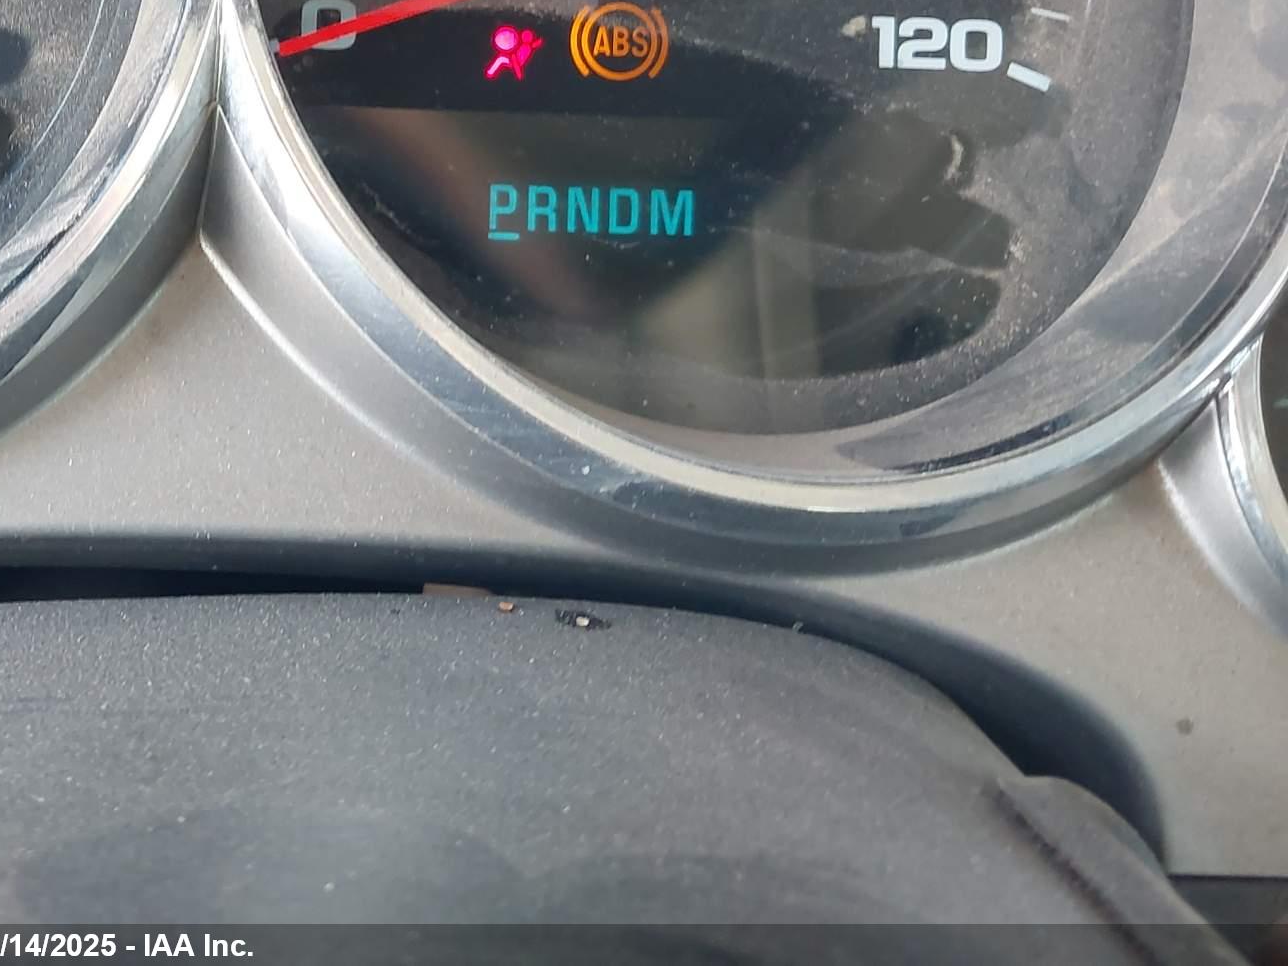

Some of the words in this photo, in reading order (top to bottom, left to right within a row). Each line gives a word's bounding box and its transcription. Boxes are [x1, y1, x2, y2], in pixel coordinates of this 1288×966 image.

[593, 27, 650, 58] ABS
[871, 16, 1003, 73] 120
[489, 184, 694, 237] PRNDM
